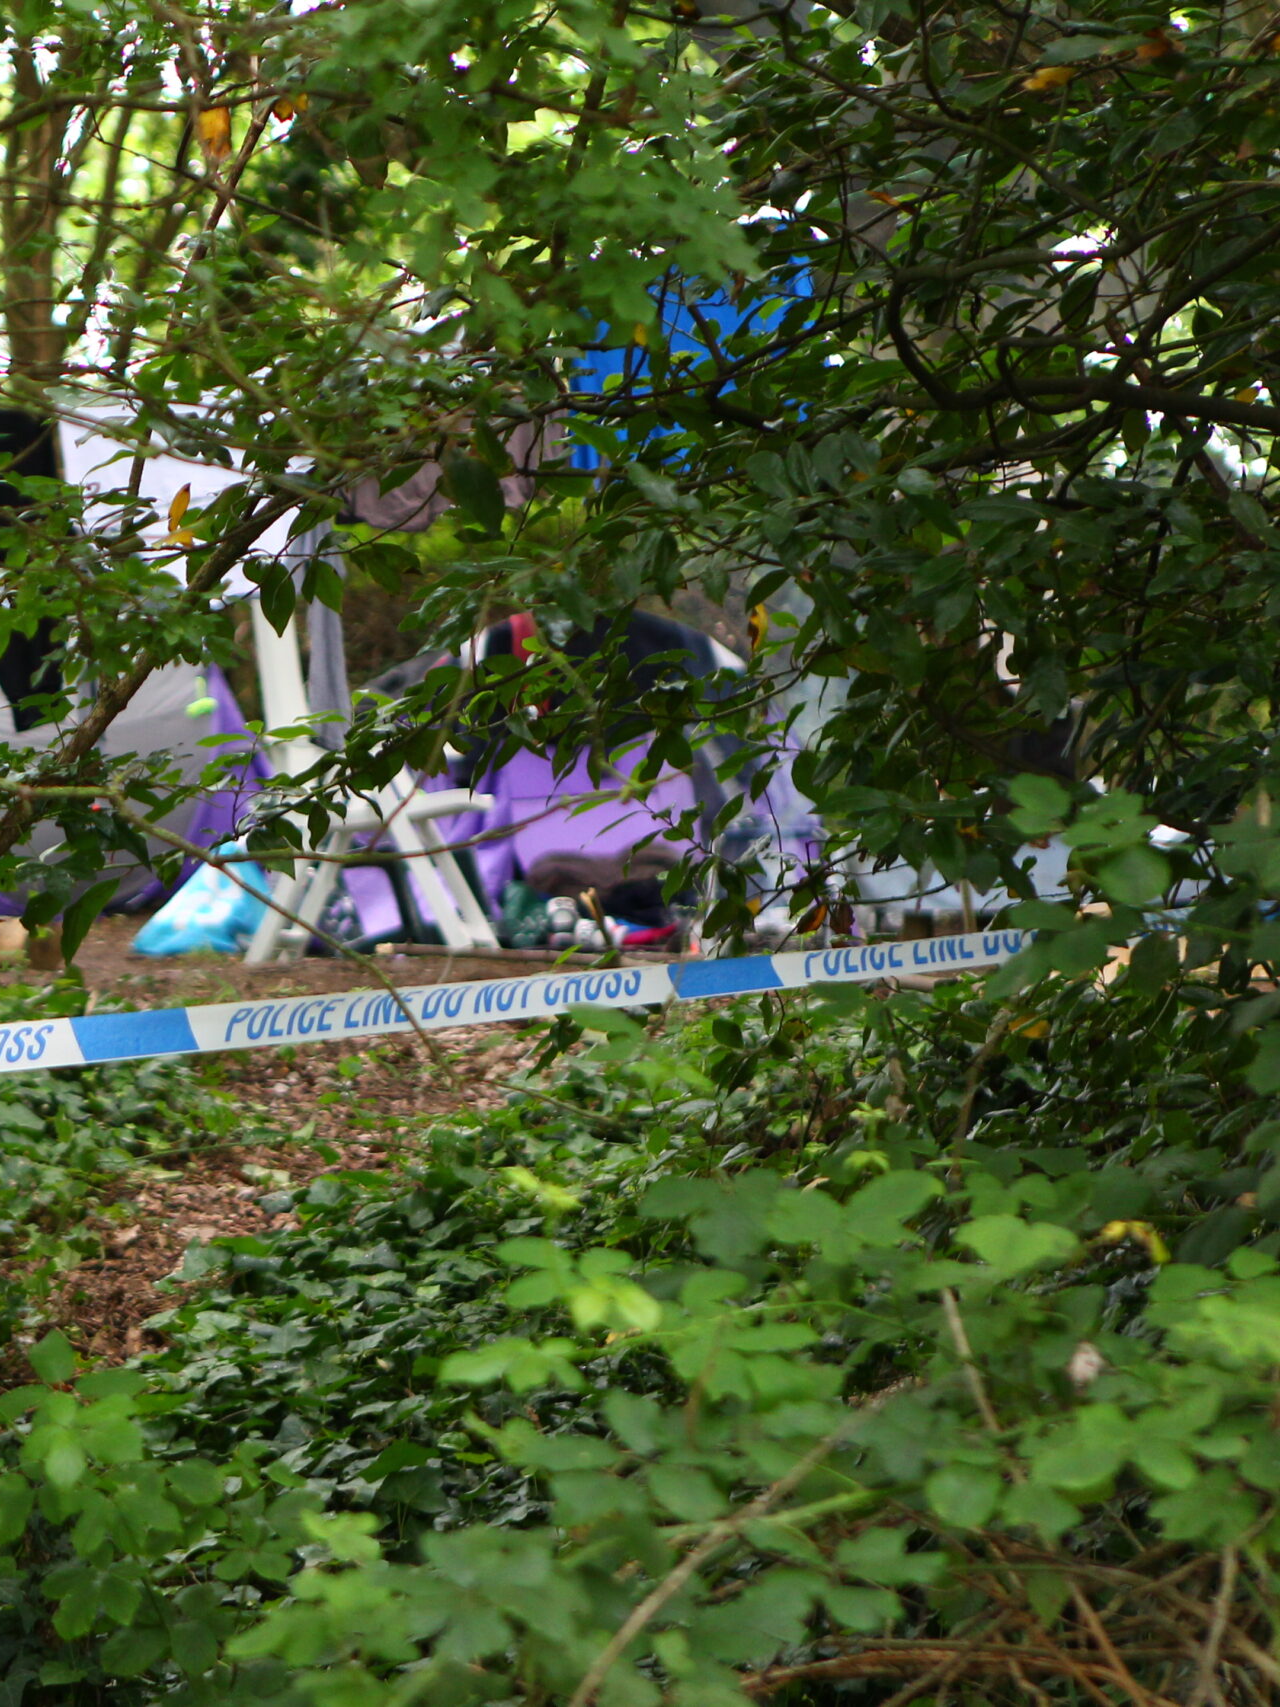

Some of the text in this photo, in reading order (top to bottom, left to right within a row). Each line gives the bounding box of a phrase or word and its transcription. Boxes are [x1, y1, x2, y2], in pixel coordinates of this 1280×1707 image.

[224, 968, 650, 1042] POLICE LINE DO NOT CROSS
